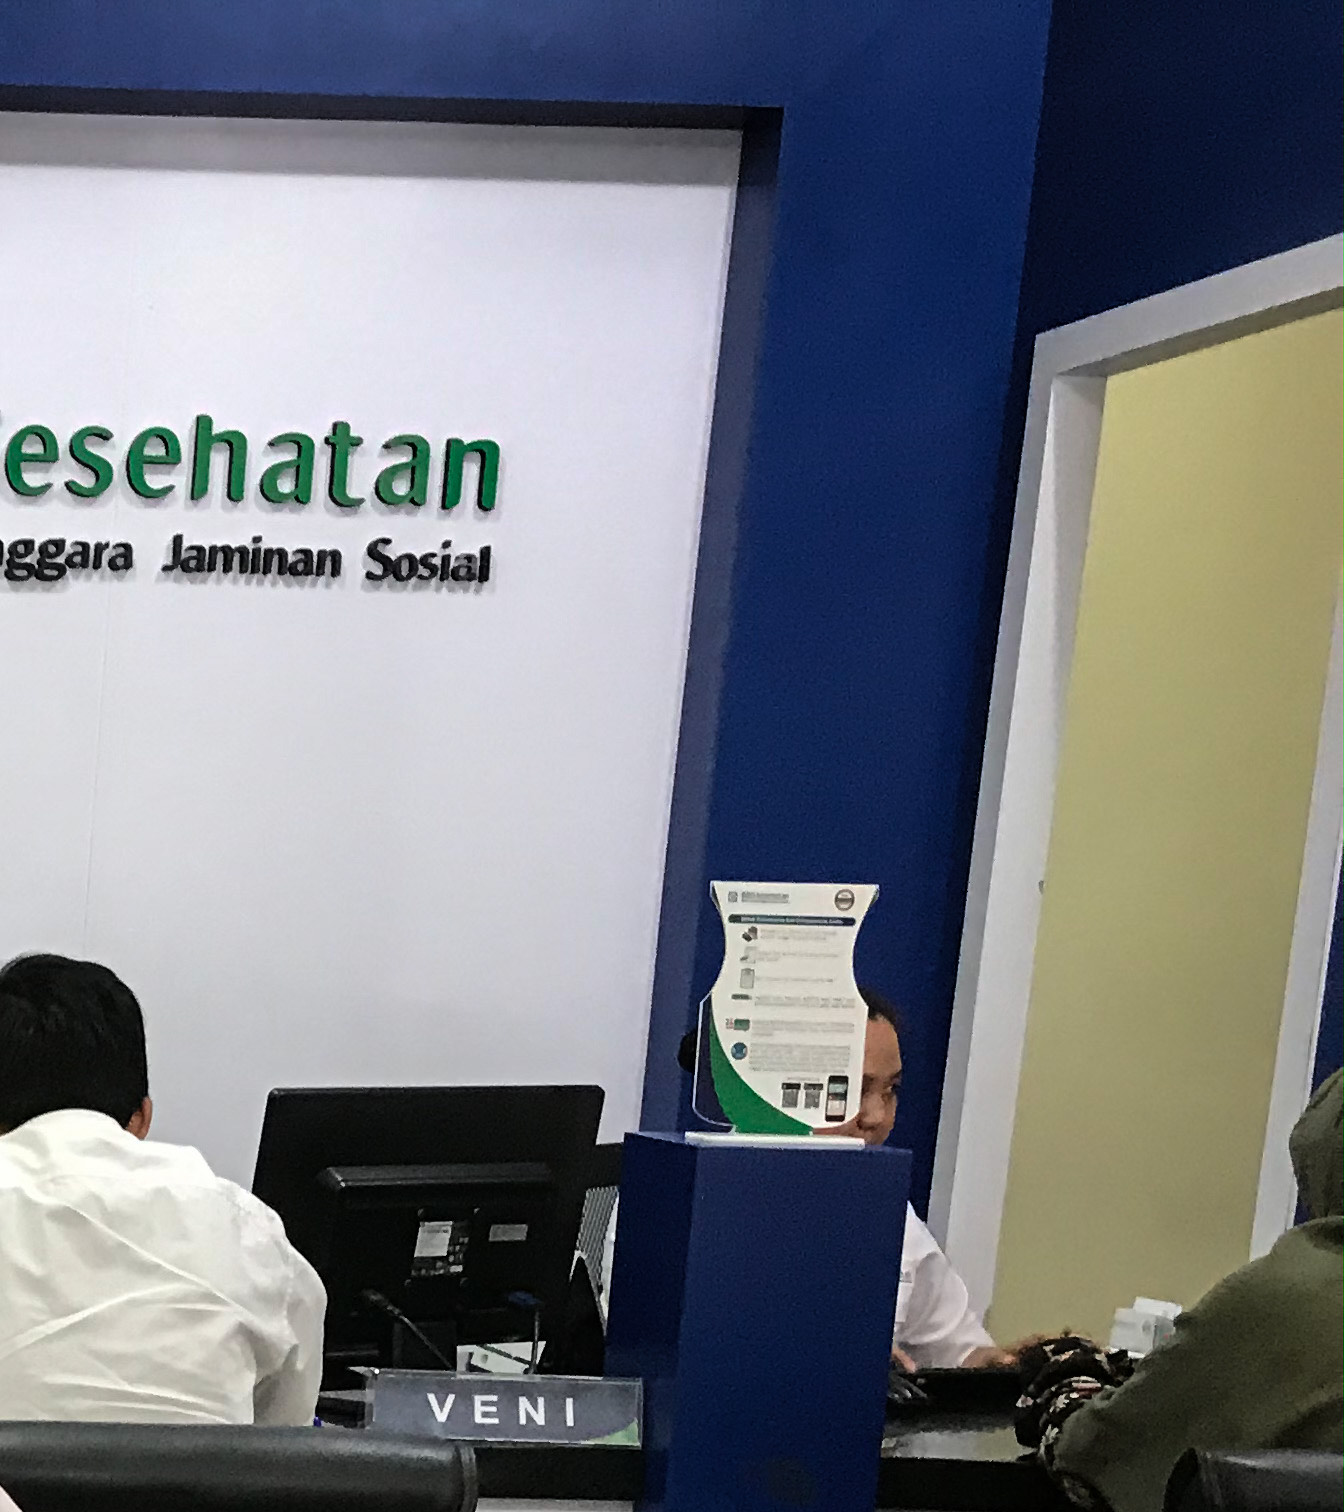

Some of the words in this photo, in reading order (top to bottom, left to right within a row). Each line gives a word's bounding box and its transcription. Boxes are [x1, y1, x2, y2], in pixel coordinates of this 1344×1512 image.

[161, 534, 343, 579] Jaminan
[364, 537, 492, 586] Sosial
[427, 1393, 575, 1427] VENI
